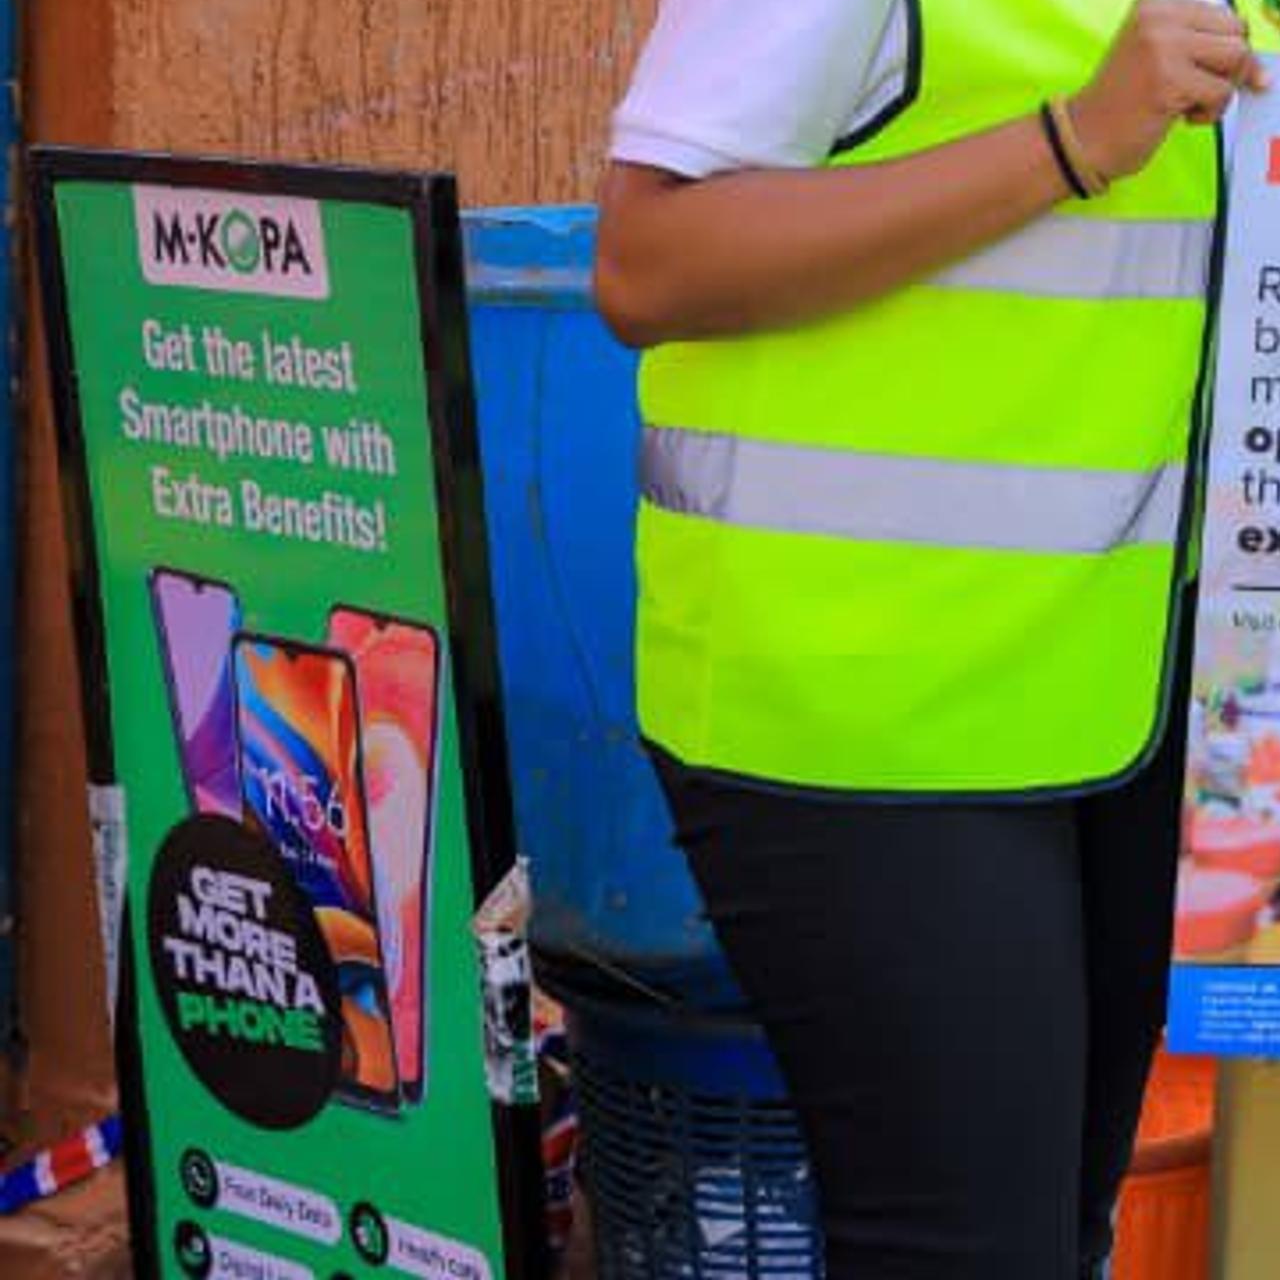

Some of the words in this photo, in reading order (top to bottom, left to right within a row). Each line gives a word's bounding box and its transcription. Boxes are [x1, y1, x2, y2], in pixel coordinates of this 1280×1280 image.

[142, 320, 194, 372] Get
[204, 327, 254, 379] the
[263, 333, 357, 392] latest
[119, 389, 313, 461] Smartphone
[321, 421, 398, 476] with
[150, 467, 234, 527] Extra
[241, 479, 388, 551] Benefits!
[191, 867, 272, 919] GET
[177, 893, 297, 974] MORE
[163, 936, 289, 1008] THAN
[294, 972, 326, 1015] A
[177, 991, 326, 1051] PHONE
